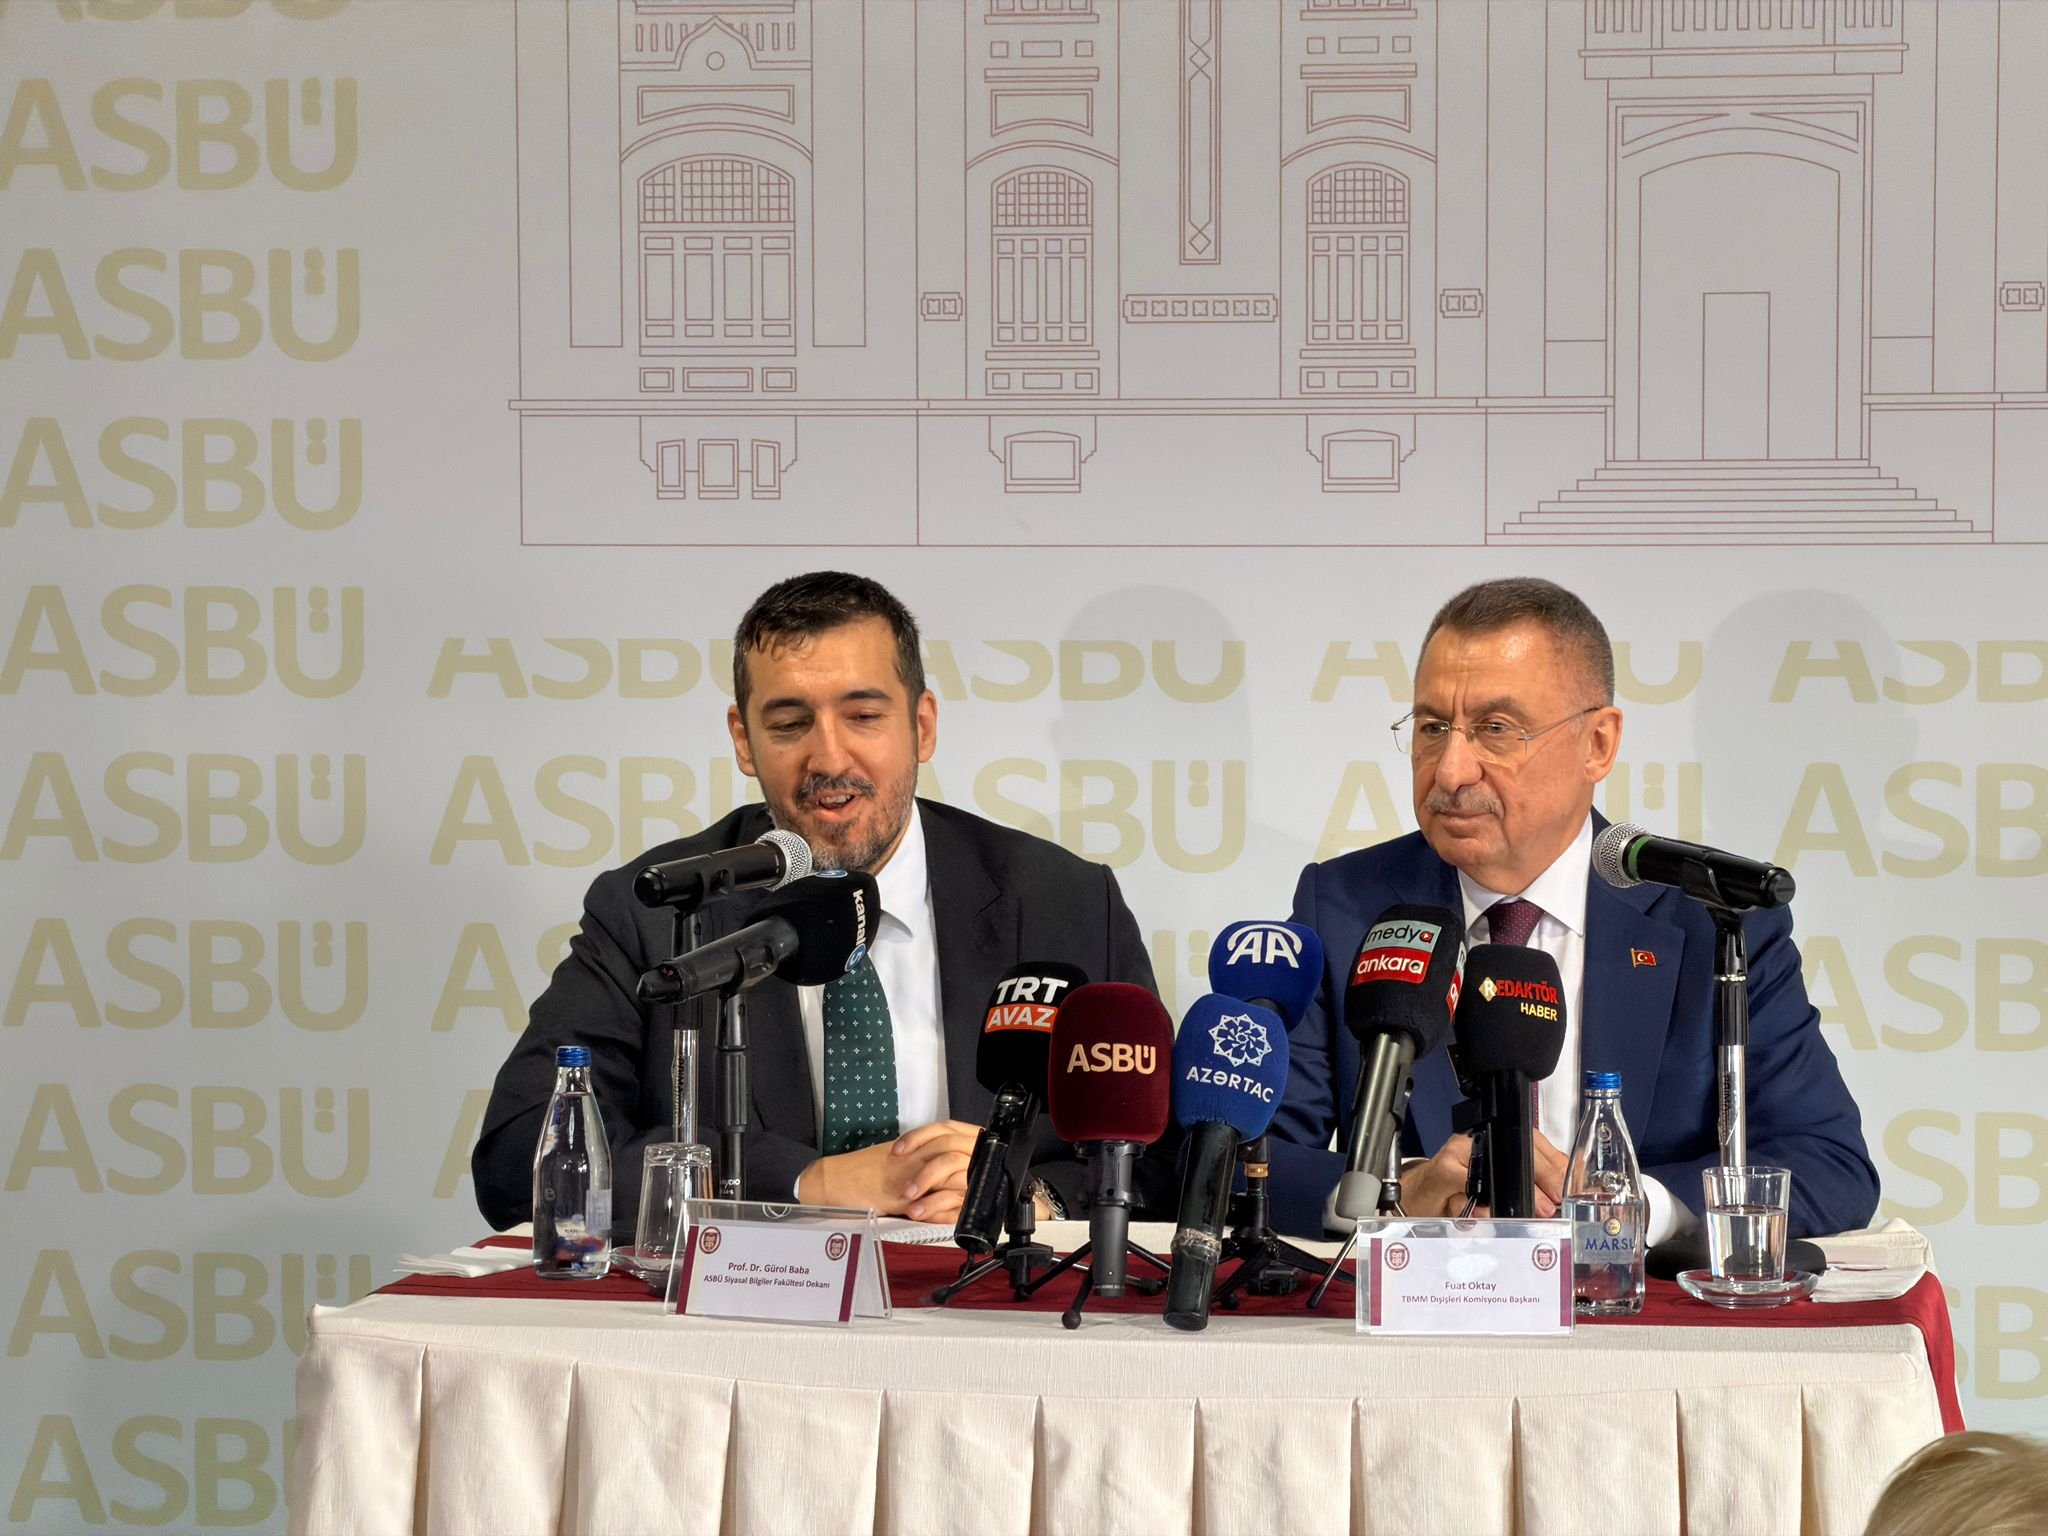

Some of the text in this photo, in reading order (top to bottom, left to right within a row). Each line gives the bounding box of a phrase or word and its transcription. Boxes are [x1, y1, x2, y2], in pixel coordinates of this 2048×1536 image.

[0, 76, 358, 192] ASBÜ
[0, 247, 361, 362] ASBÜ
[0, 416, 363, 531] ASBÜ
[0, 584, 365, 698] ASBÜ
[0, 751, 367, 866] ASBÜ
[1773, 761, 2048, 878] ASB
[853, 889, 867, 946] kanal
[1366, 925, 1434, 944] medya
[1226, 925, 1302, 968] AA
[1357, 956, 1424, 975] ankara
[2, 917, 370, 1032] ASBÜ
[996, 976, 1068, 1004] TRT
[1481, 978, 1558, 1005] REDAKTÖR
[1801, 935, 2048, 1052] ASB
[987, 1007, 1055, 1029] AVAZ
[1520, 1002, 1558, 1022] HABER
[1066, 1042, 1156, 1075] ASBÜ
[1186, 1065, 1274, 1103] AZƏRTAC
[4, 1083, 371, 1198] ASBÜ
[703, 1273, 830, 1289] ASBÜ Siyasal Bilgiler Fakültesi Dekanı
[728, 1262, 809, 1275] Prof. Dr. Gürol Baba
[1445, 1281, 1496, 1293] Fuat Oktay
[1401, 1295, 1428, 1304] TBMM
[1463, 1295, 1507, 1305] Komisyonu
[1509, 1295, 1540, 1305] Başkanı
[8, 1414, 297, 1527] ASB
